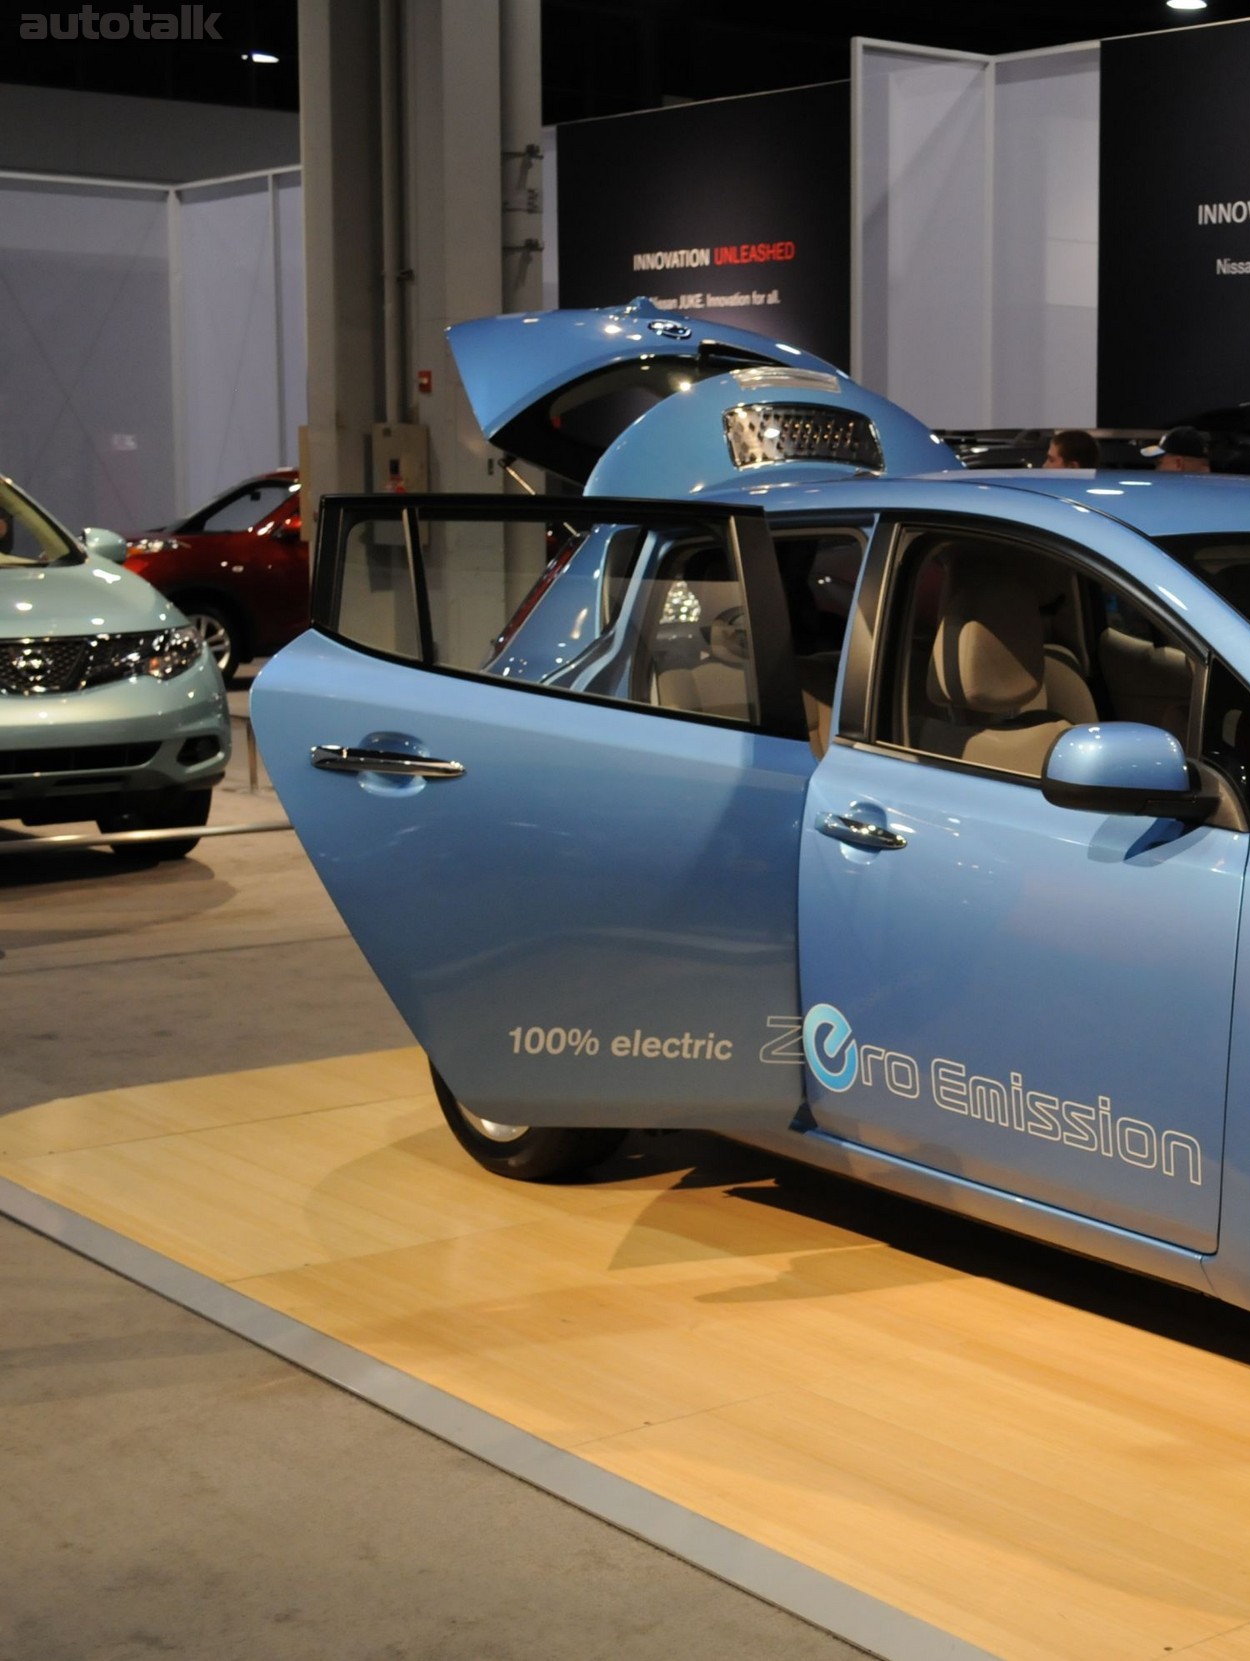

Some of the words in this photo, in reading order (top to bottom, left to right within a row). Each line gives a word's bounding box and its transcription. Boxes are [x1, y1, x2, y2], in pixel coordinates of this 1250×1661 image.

[633, 248, 711, 272] INNOVATION
[713, 240, 796, 266] UNLEASHED
[706, 291, 751, 308] Innovation
[752, 289, 766, 306] for
[508, 1026, 600, 1055] 100%
[610, 1029, 734, 1061] electric
[931, 1058, 1201, 1186] Emission
